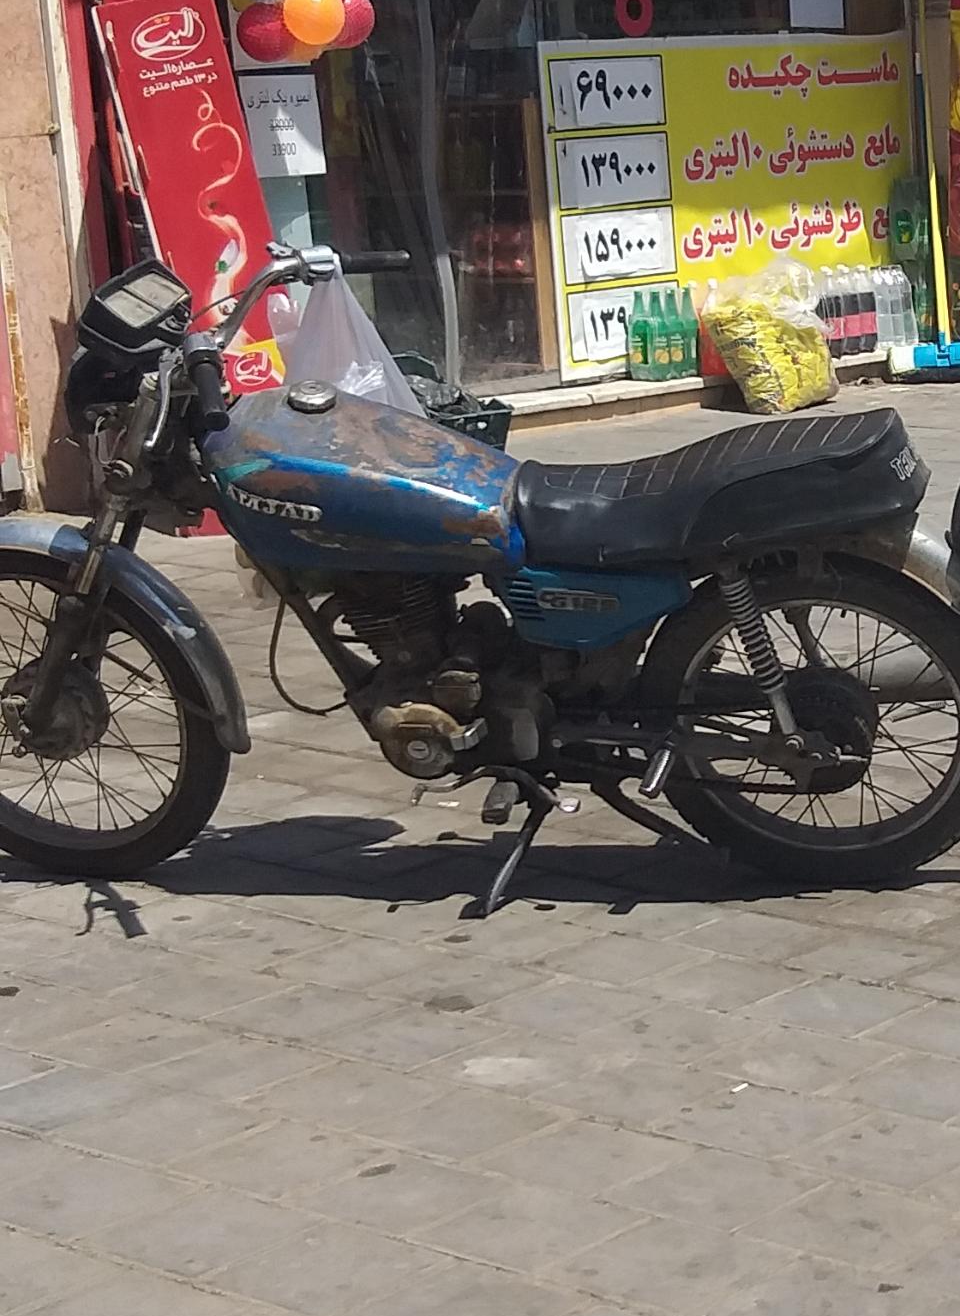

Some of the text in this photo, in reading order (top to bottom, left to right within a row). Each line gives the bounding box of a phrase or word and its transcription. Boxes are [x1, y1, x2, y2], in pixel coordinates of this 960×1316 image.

[135, 7, 195, 49] الیت
[138, 57, 215, 81] عصاره الیت
[170, 75, 194, 92] طعم
[206, 71, 219, 84] در
[728, 51, 899, 98] ماست چکیده
[142, 81, 170, 98] متنوع
[576, 69, 653, 113] ۶۹۰۰۰
[768, 126, 855, 175] دستشوئی
[864, 122, 901, 166] مایع
[580, 151, 657, 188] ۱۳۹۰۰۰
[583, 227, 657, 264] ۱۵۹۰۰۰
[683, 210, 739, 260] لیتری
